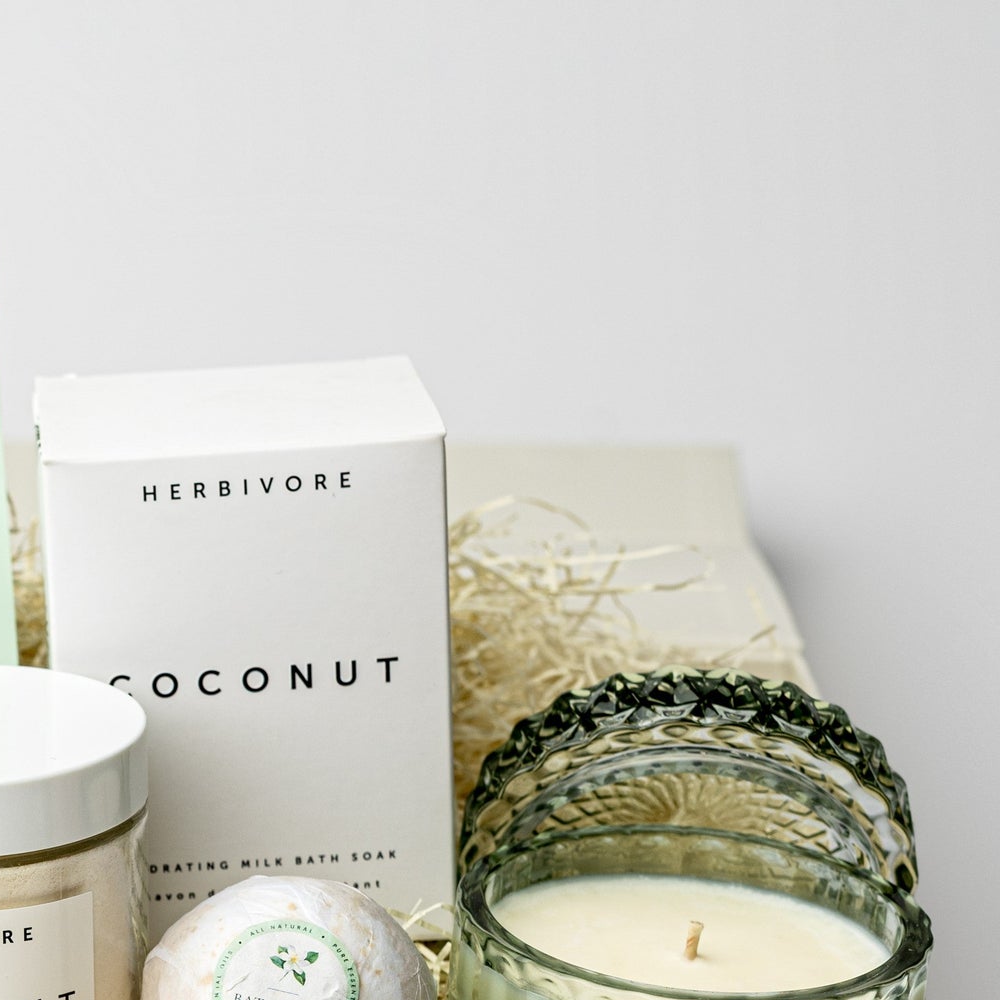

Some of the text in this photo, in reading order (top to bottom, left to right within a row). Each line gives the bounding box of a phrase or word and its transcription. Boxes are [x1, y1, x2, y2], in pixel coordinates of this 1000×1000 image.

[142, 471, 353, 502] HERBIVORE
[149, 850, 396, 874] DRATING MILK BATH SOAK
[155, 892, 196, 902] avon
[270, 924, 313, 933] NATURAL
